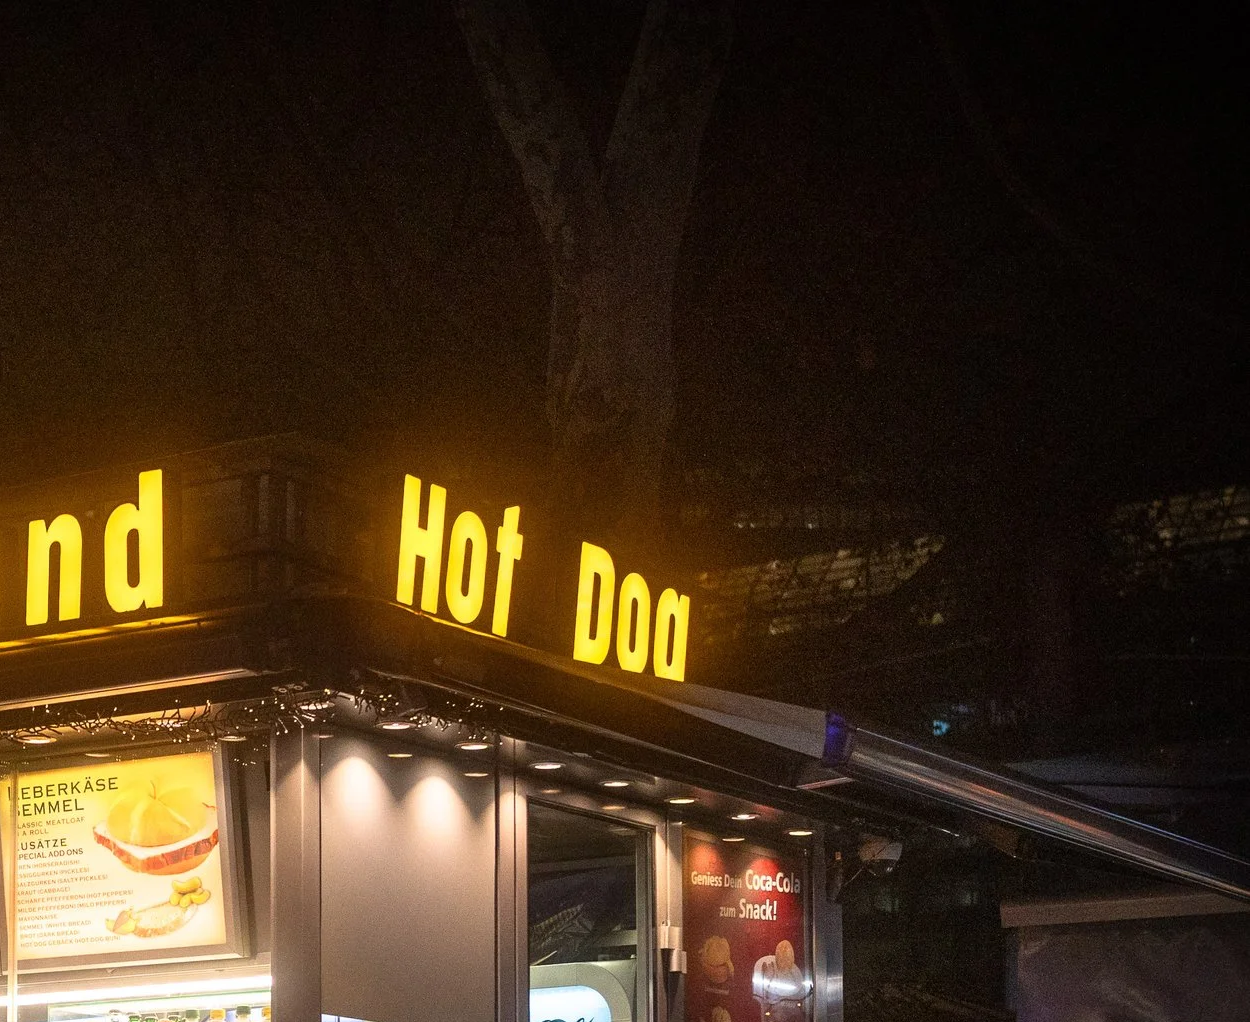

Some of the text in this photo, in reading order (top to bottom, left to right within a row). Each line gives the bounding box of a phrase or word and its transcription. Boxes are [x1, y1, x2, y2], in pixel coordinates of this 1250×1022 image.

[396, 473, 524, 638] Hot
[18, 817, 85, 829] LASSIC MEATLOAF
[18, 838, 67, 851] USÄTZE
[18, 852, 46, 860] PECIAL
[18, 870, 58, 878] SSIGGURKEN
[691, 869, 801, 894] Geniess Dein Coca-Cola
[719, 899, 777, 921] zum Snack!
